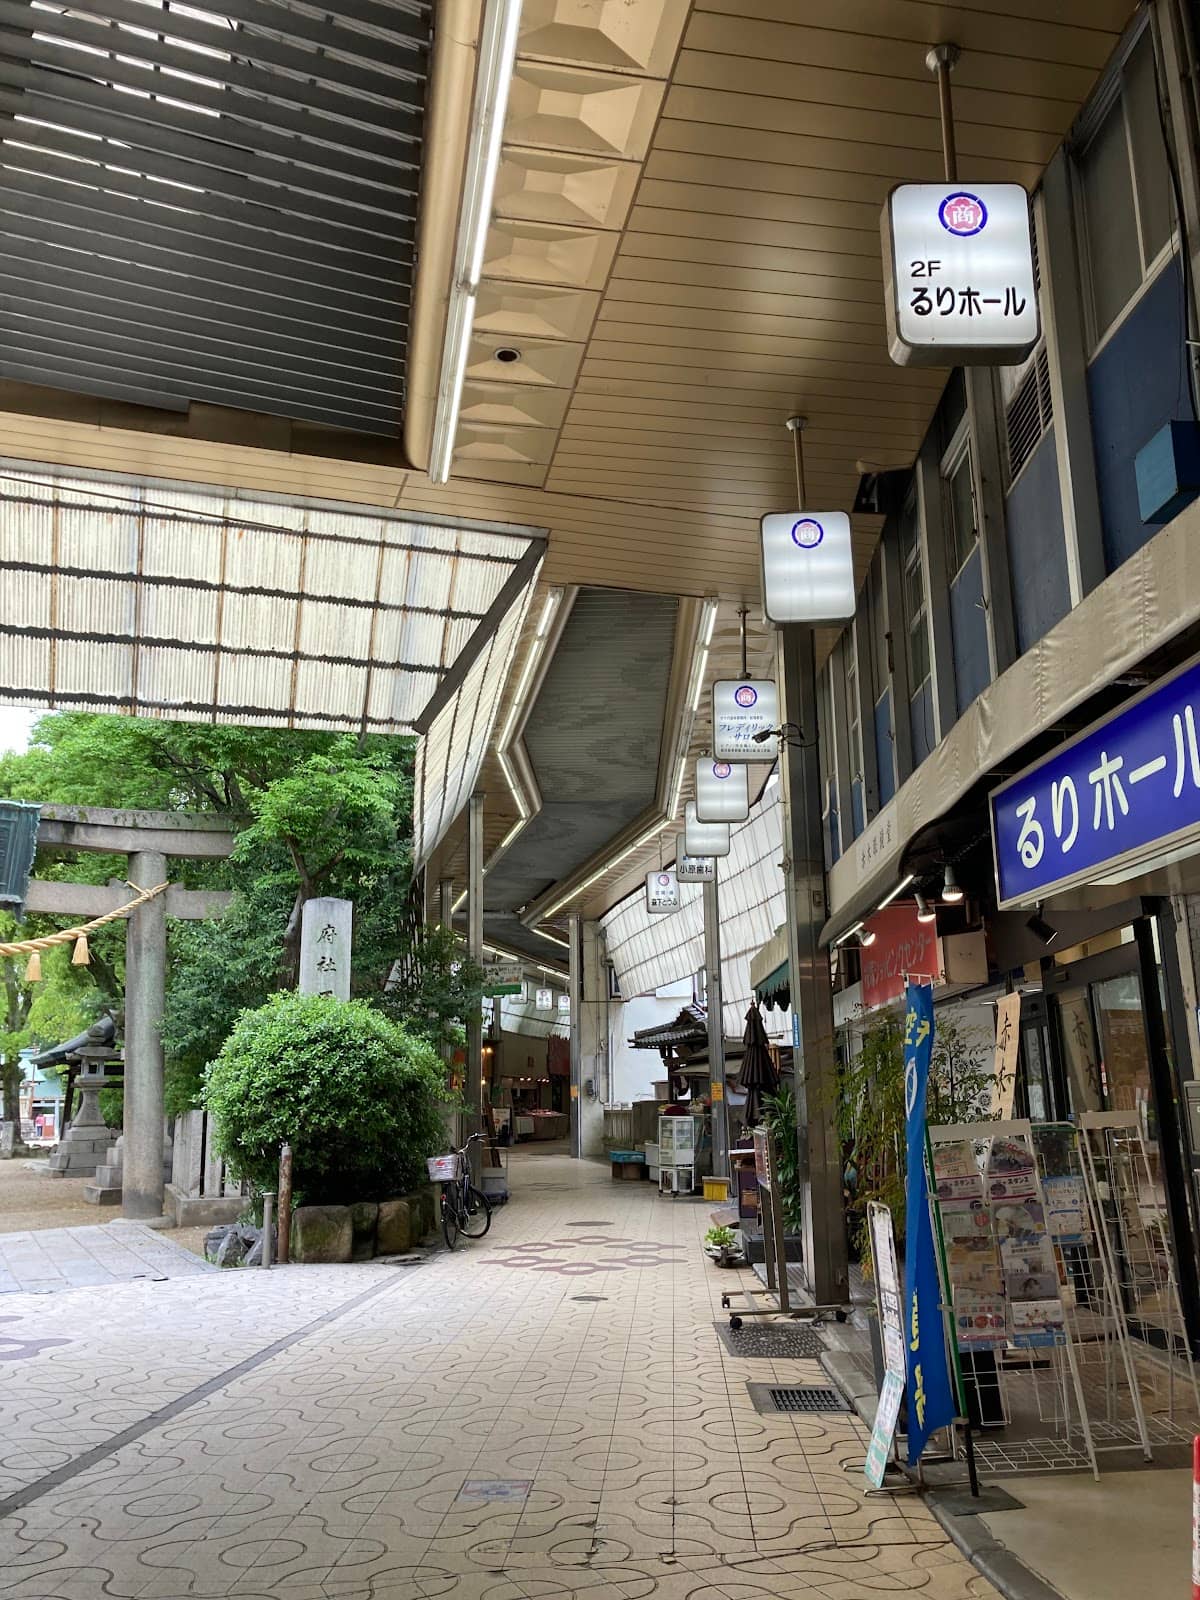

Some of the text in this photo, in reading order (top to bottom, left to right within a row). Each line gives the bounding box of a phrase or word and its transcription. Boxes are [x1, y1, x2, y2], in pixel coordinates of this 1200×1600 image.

[910, 260, 941, 278] 2F
[910, 285, 1026, 317] るりホール
[734, 732, 751, 741] サロ
[1015, 704, 1200, 869] るりホール
